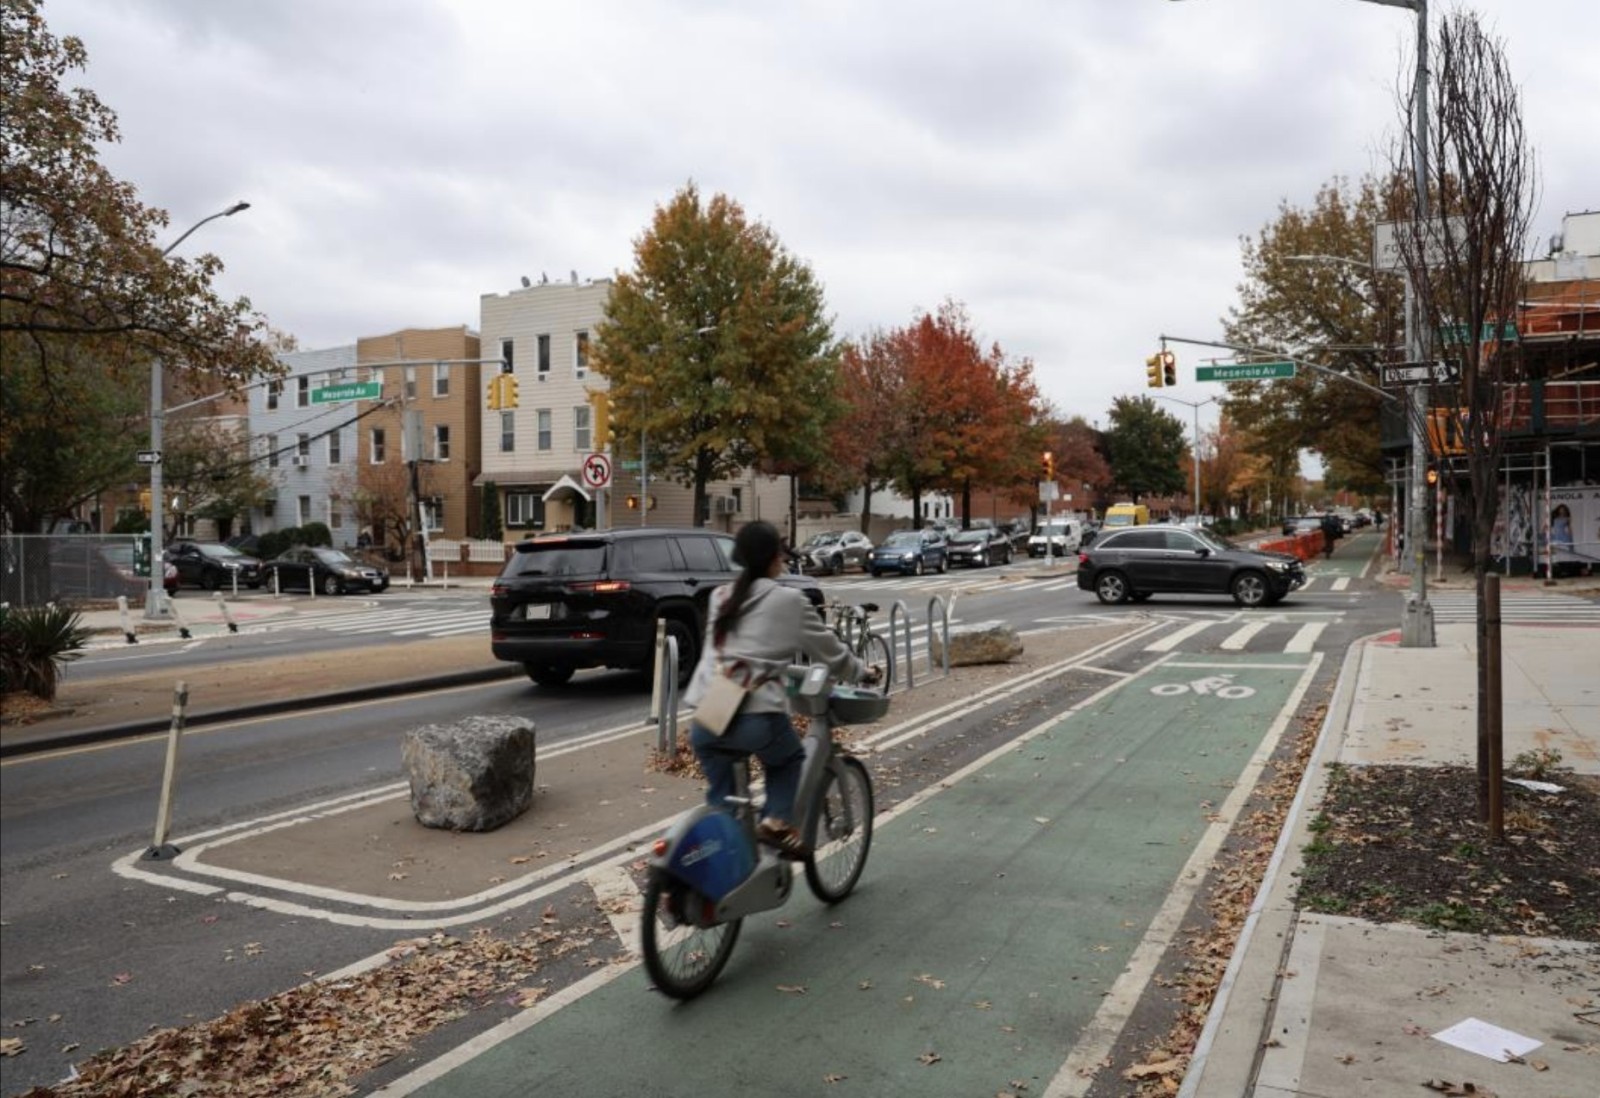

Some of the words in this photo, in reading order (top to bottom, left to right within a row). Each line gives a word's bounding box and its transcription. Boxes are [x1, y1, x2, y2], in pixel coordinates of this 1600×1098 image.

[1213, 367, 1261, 378] Meserole
[1262, 366, 1277, 376] Av
[1388, 368, 1413, 380] ONE
